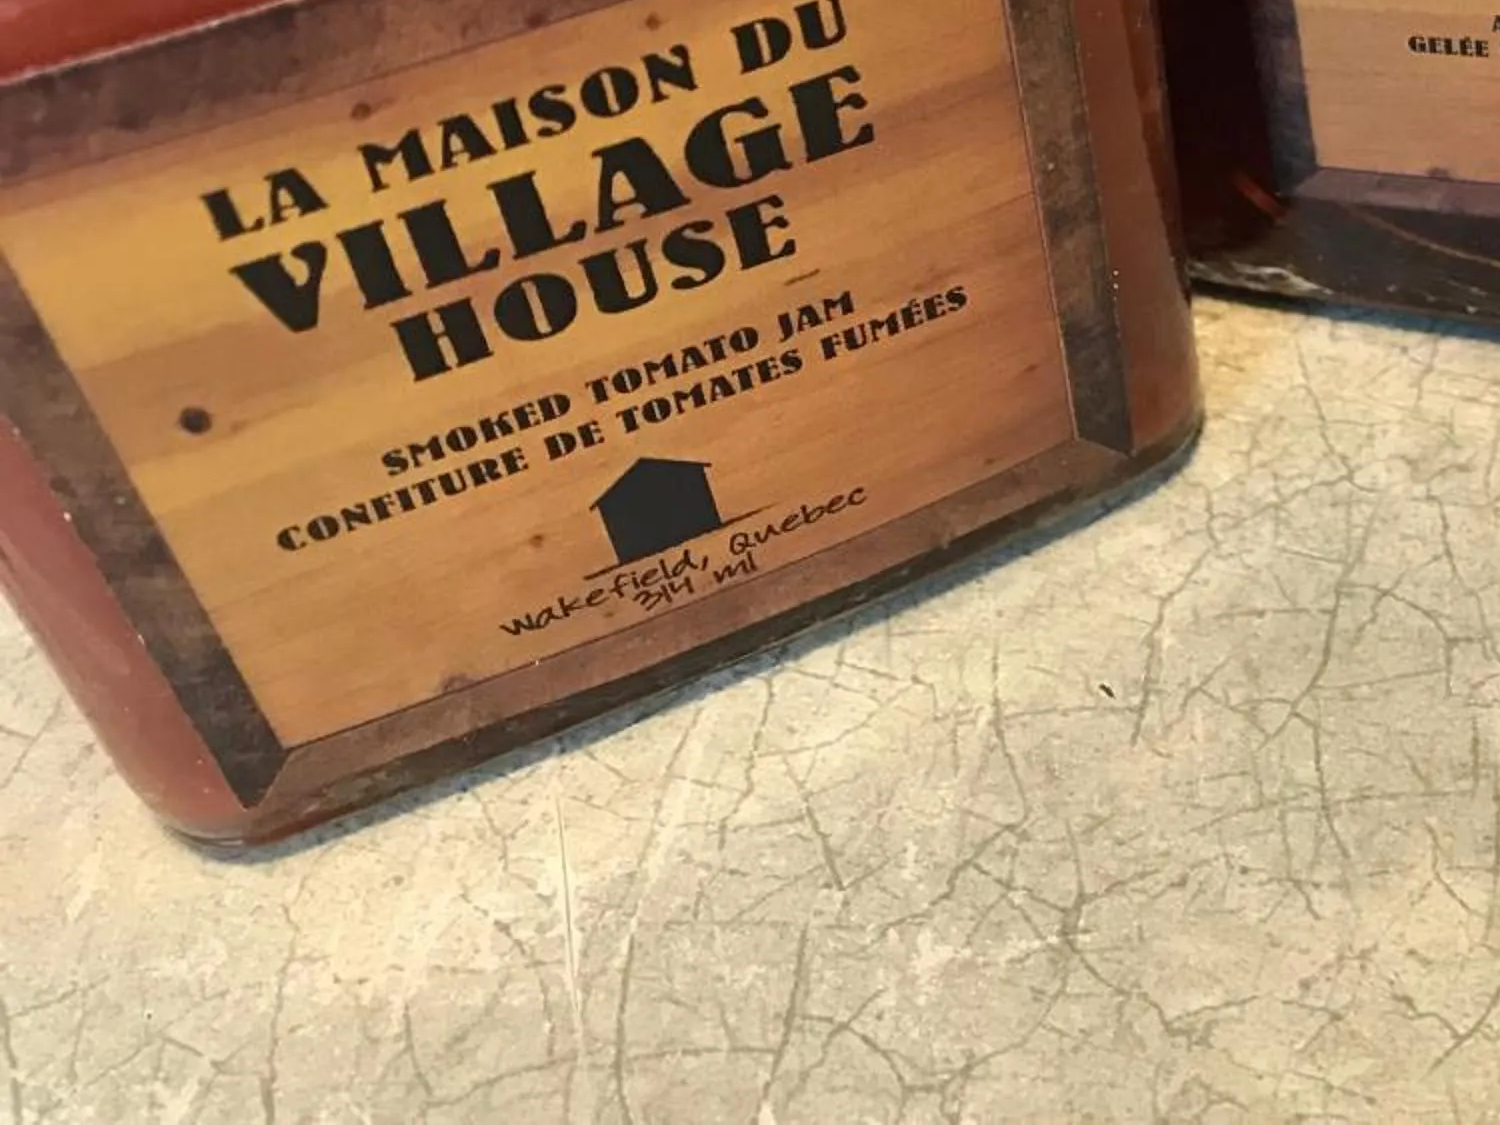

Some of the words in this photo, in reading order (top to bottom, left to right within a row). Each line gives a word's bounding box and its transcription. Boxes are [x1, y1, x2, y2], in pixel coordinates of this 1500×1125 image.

[1407, 35, 1490, 59] GELÉE
[199, 167, 330, 241] LA
[357, 43, 699, 195] MAISON
[229, 64, 876, 335] VILLAGE
[389, 193, 797, 383] HOUSE
[276, 446, 529, 553] CONFITURE
[544, 420, 603, 463] DE
[615, 348, 803, 436] TOMATES
[820, 284, 969, 363] FUMÉES
[381, 392, 571, 478] SMOKED
[584, 323, 759, 406] TOMATO
[776, 289, 856, 343] JAM
[633, 576, 695, 612] 314
[715, 554, 759, 587] ml
[728, 486, 868, 556] Quebec
